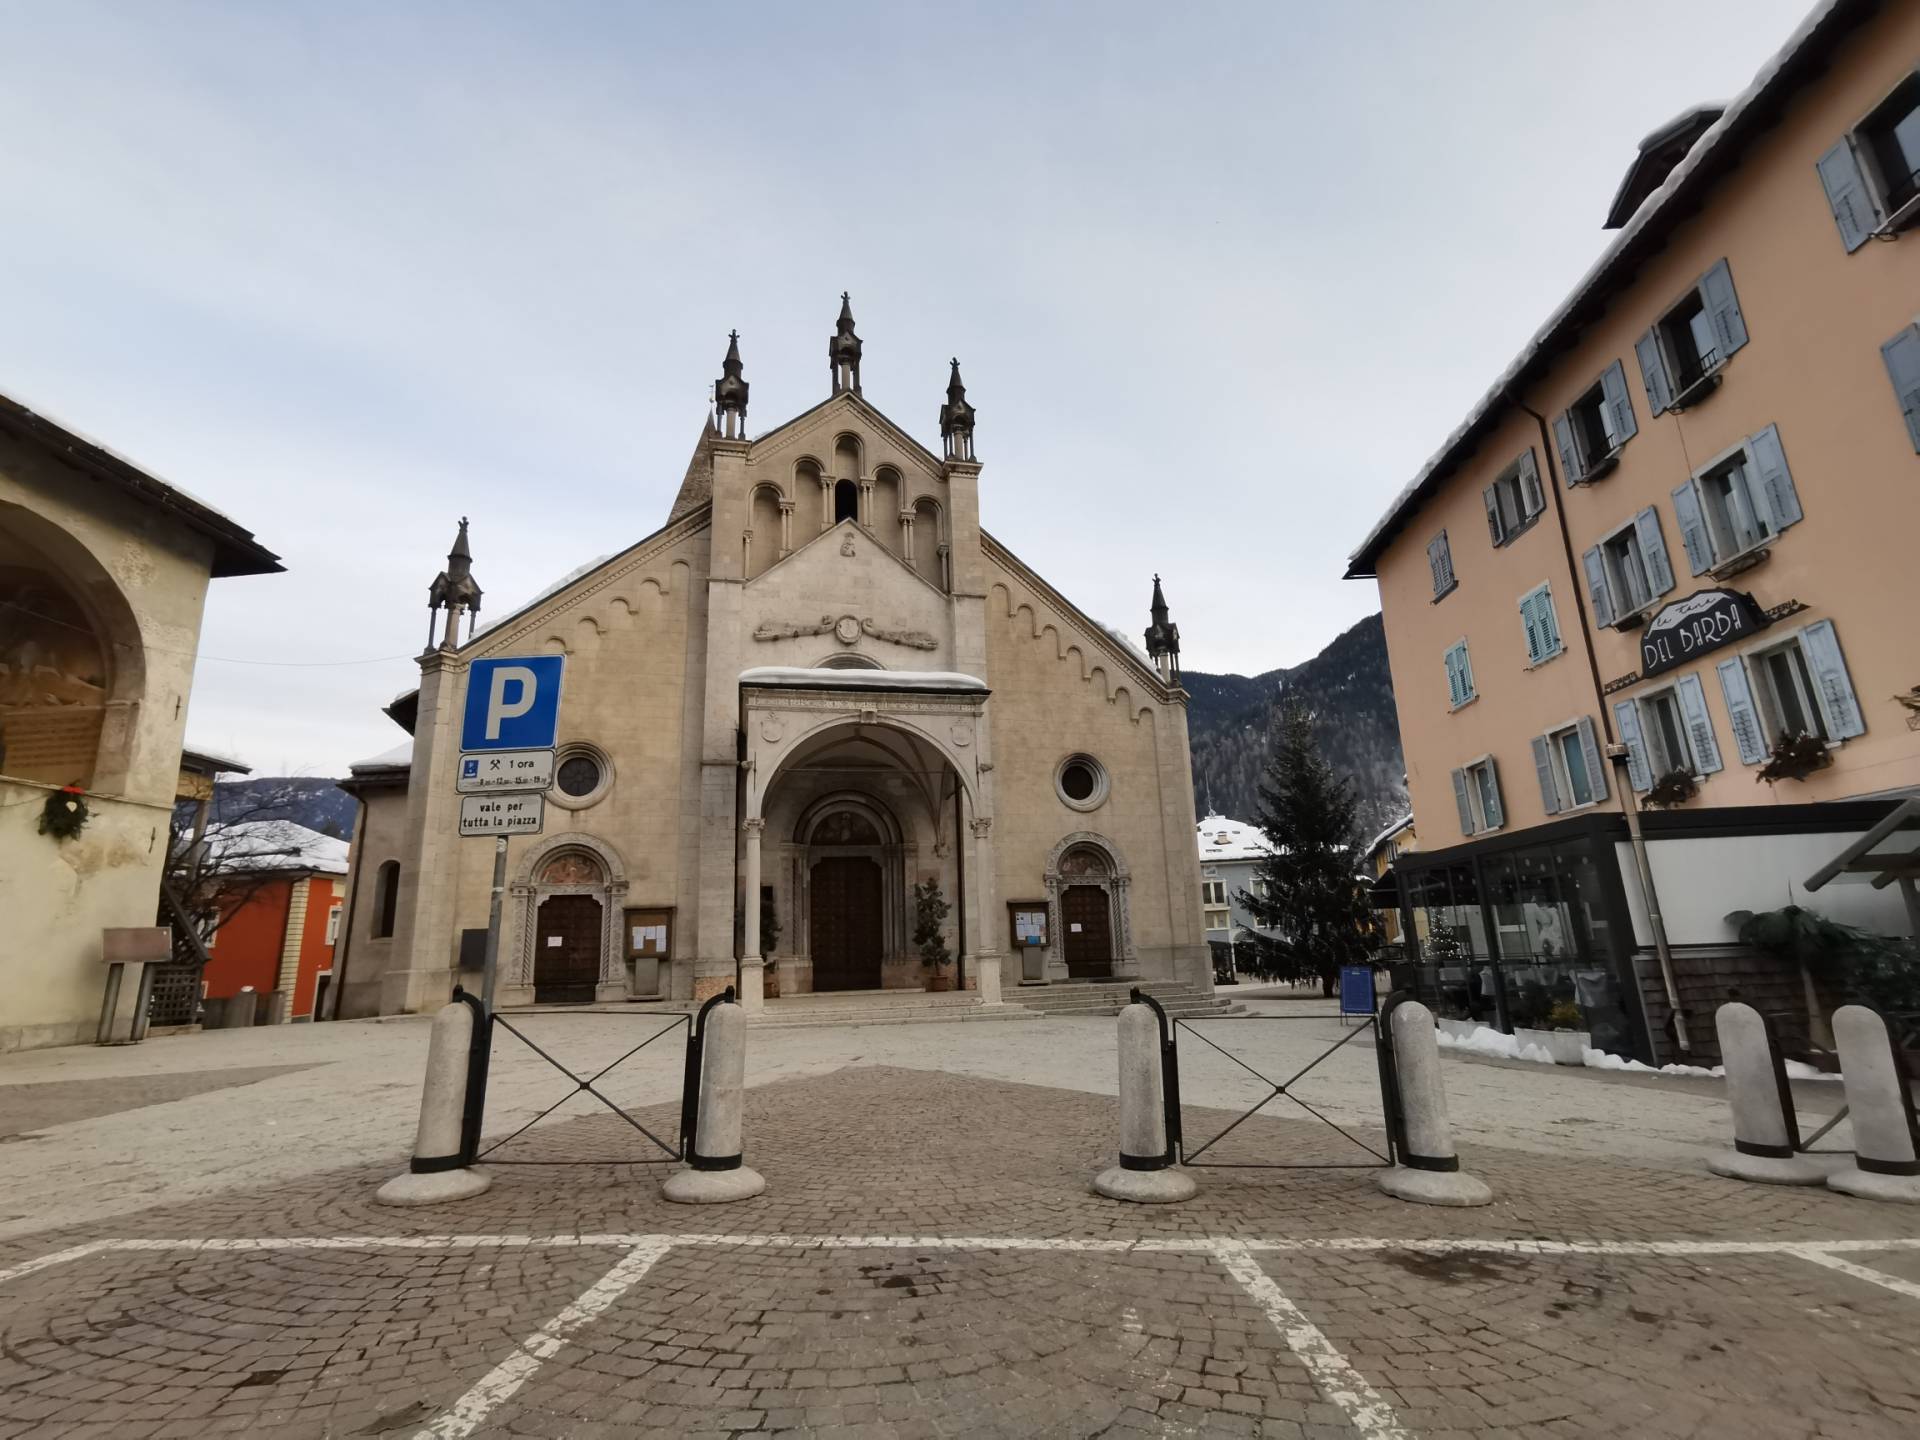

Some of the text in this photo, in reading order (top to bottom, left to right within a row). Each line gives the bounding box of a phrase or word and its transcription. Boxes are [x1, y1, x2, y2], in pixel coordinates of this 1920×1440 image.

[1644, 604, 1742, 669] DEL BARBA
[485, 667, 537, 740] P
[463, 815, 536, 827] tutta la piazza
[480, 802, 523, 812] vale per
